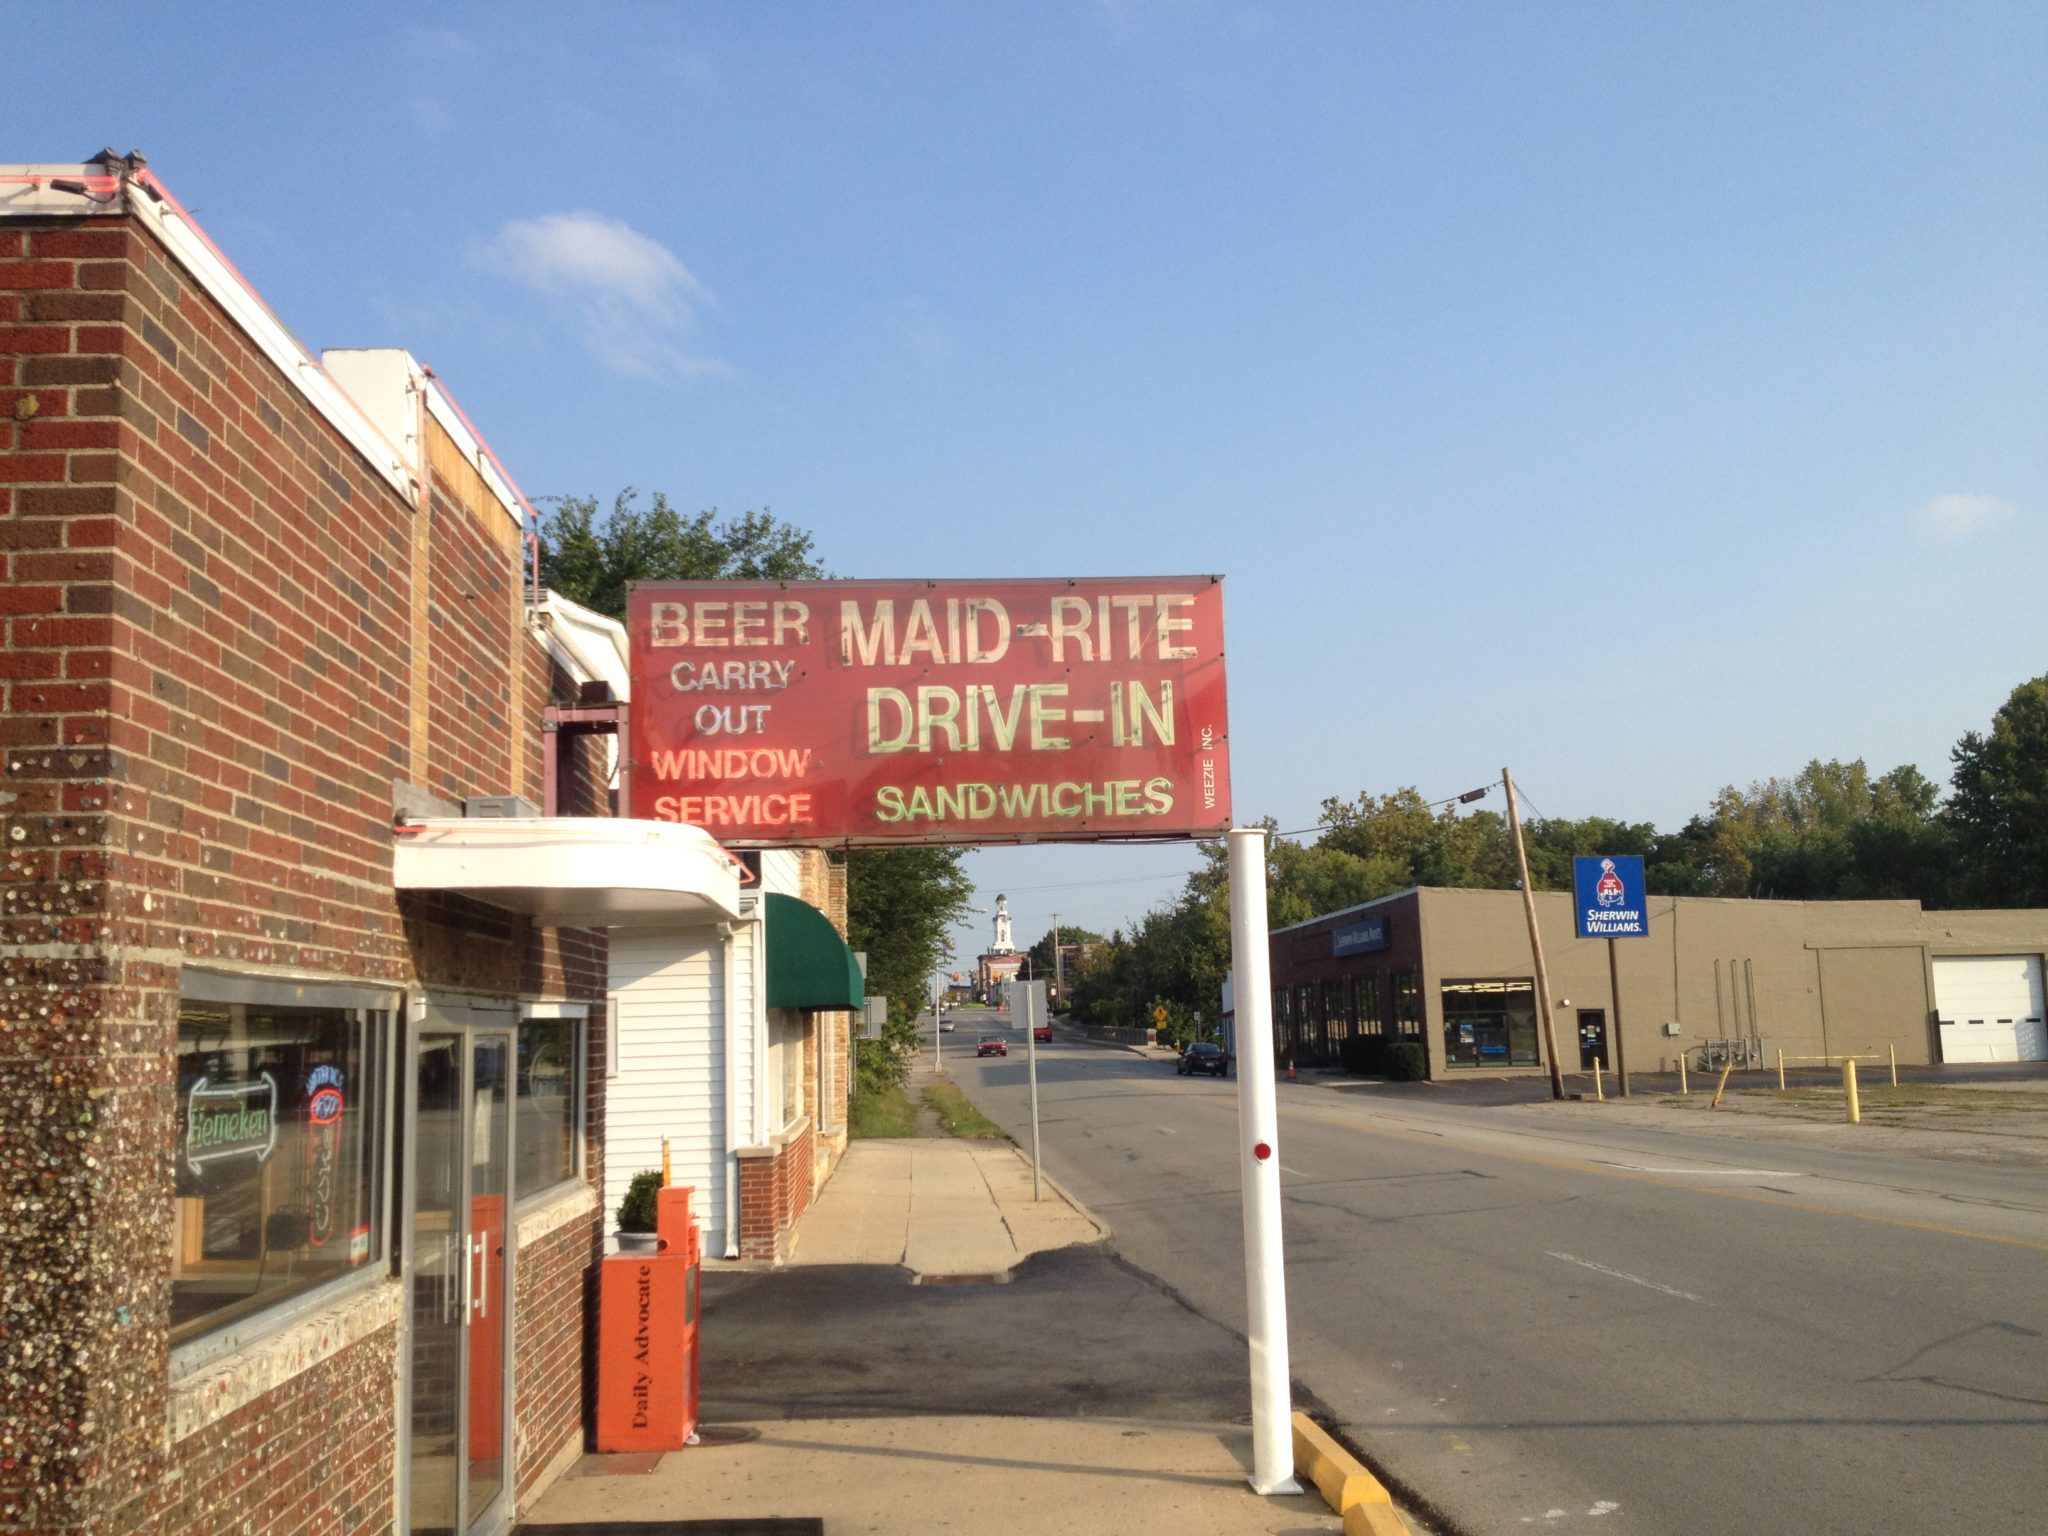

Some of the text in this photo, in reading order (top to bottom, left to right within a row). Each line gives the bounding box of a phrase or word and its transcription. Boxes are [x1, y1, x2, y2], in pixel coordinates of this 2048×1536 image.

[651, 601, 810, 647] BEER
[841, 594, 1197, 666] MAID-RITE
[670, 660, 795, 691] CARRY
[694, 704, 771, 735] OUT
[867, 680, 1175, 753] DRIVE-IN
[651, 748, 811, 780] WINDOW
[1201, 724, 1215, 809] WEEZIE INC.
[654, 794, 813, 825] SERVICE
[875, 777, 1173, 822] SANDWICHES
[1587, 909, 1639, 921] SHERWIN
[1587, 921, 1640, 932] WILLIAMS
[633, 1265, 653, 1429] Daily Advocate
